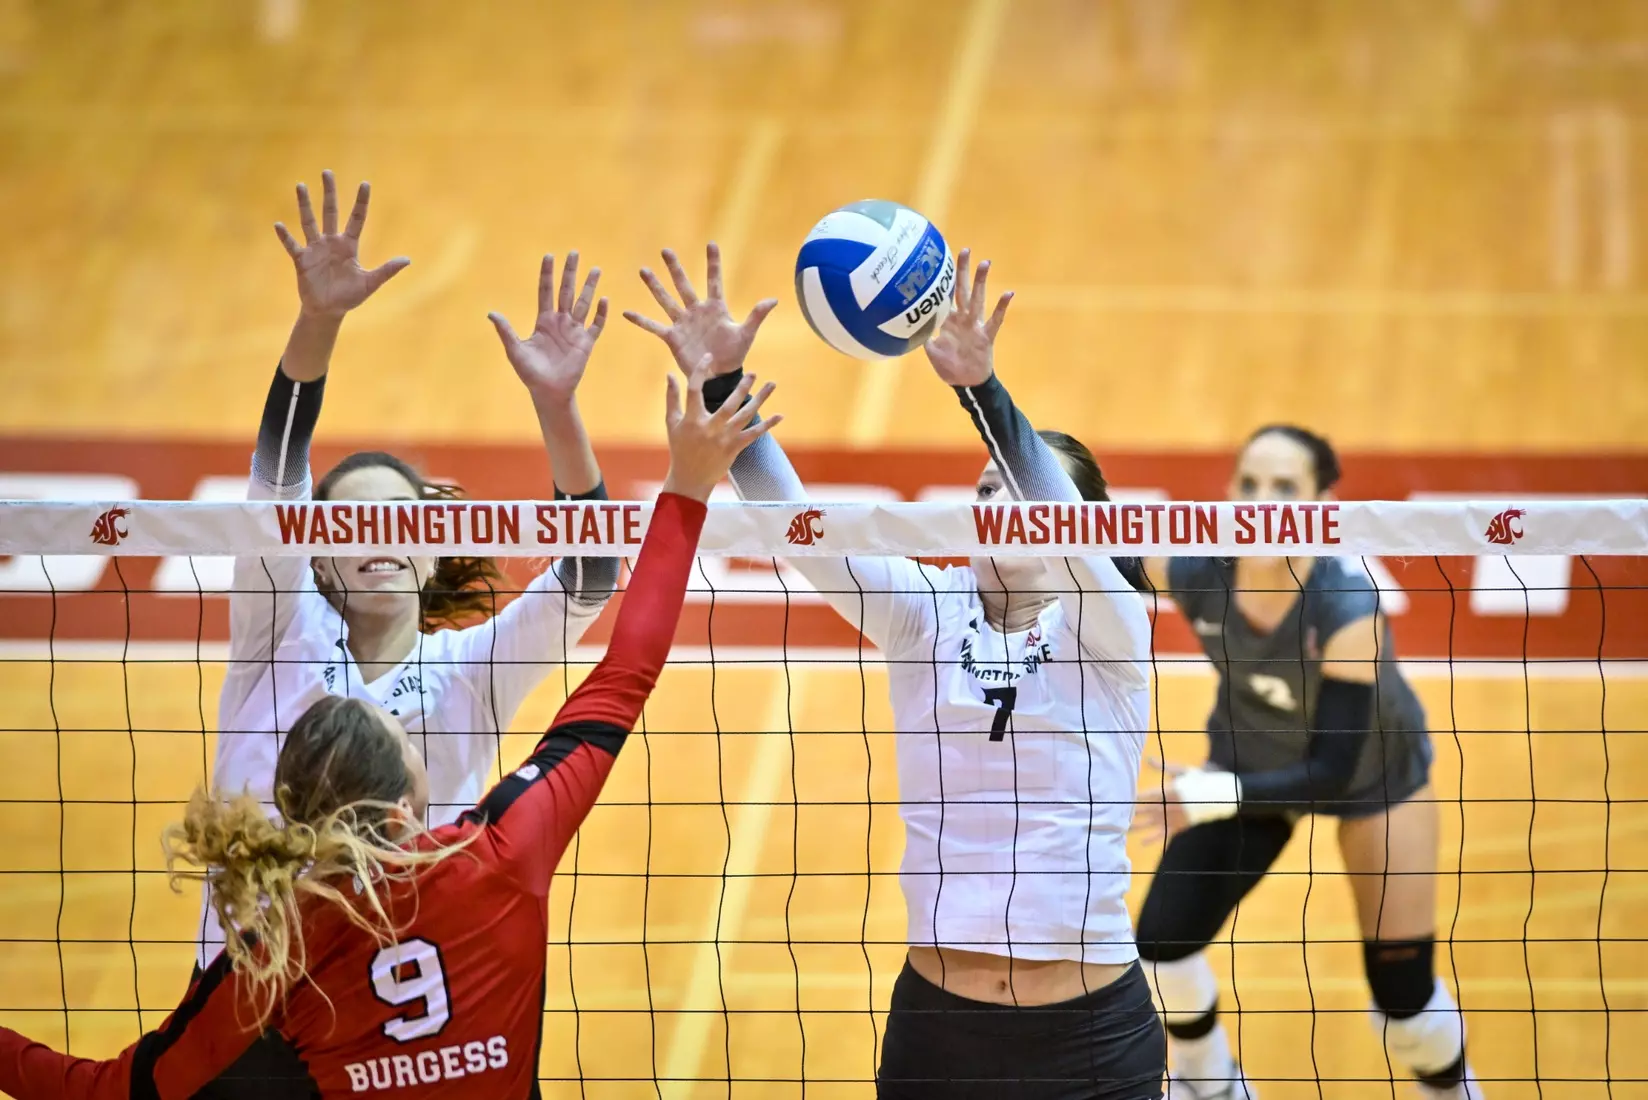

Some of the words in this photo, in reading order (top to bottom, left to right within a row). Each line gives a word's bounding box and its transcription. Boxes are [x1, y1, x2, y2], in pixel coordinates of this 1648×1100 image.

[895, 235, 944, 303] NCAA
[905, 255, 955, 325] molten
[274, 504, 520, 545] WASHINGTON
[534, 504, 642, 545] STATE
[971, 504, 1219, 545] WASHINGTON
[1234, 504, 1341, 545] STATE
[980, 686, 1017, 742] 7
[368, 936, 452, 1044] 9
[344, 1035, 509, 1092] BURGESS
